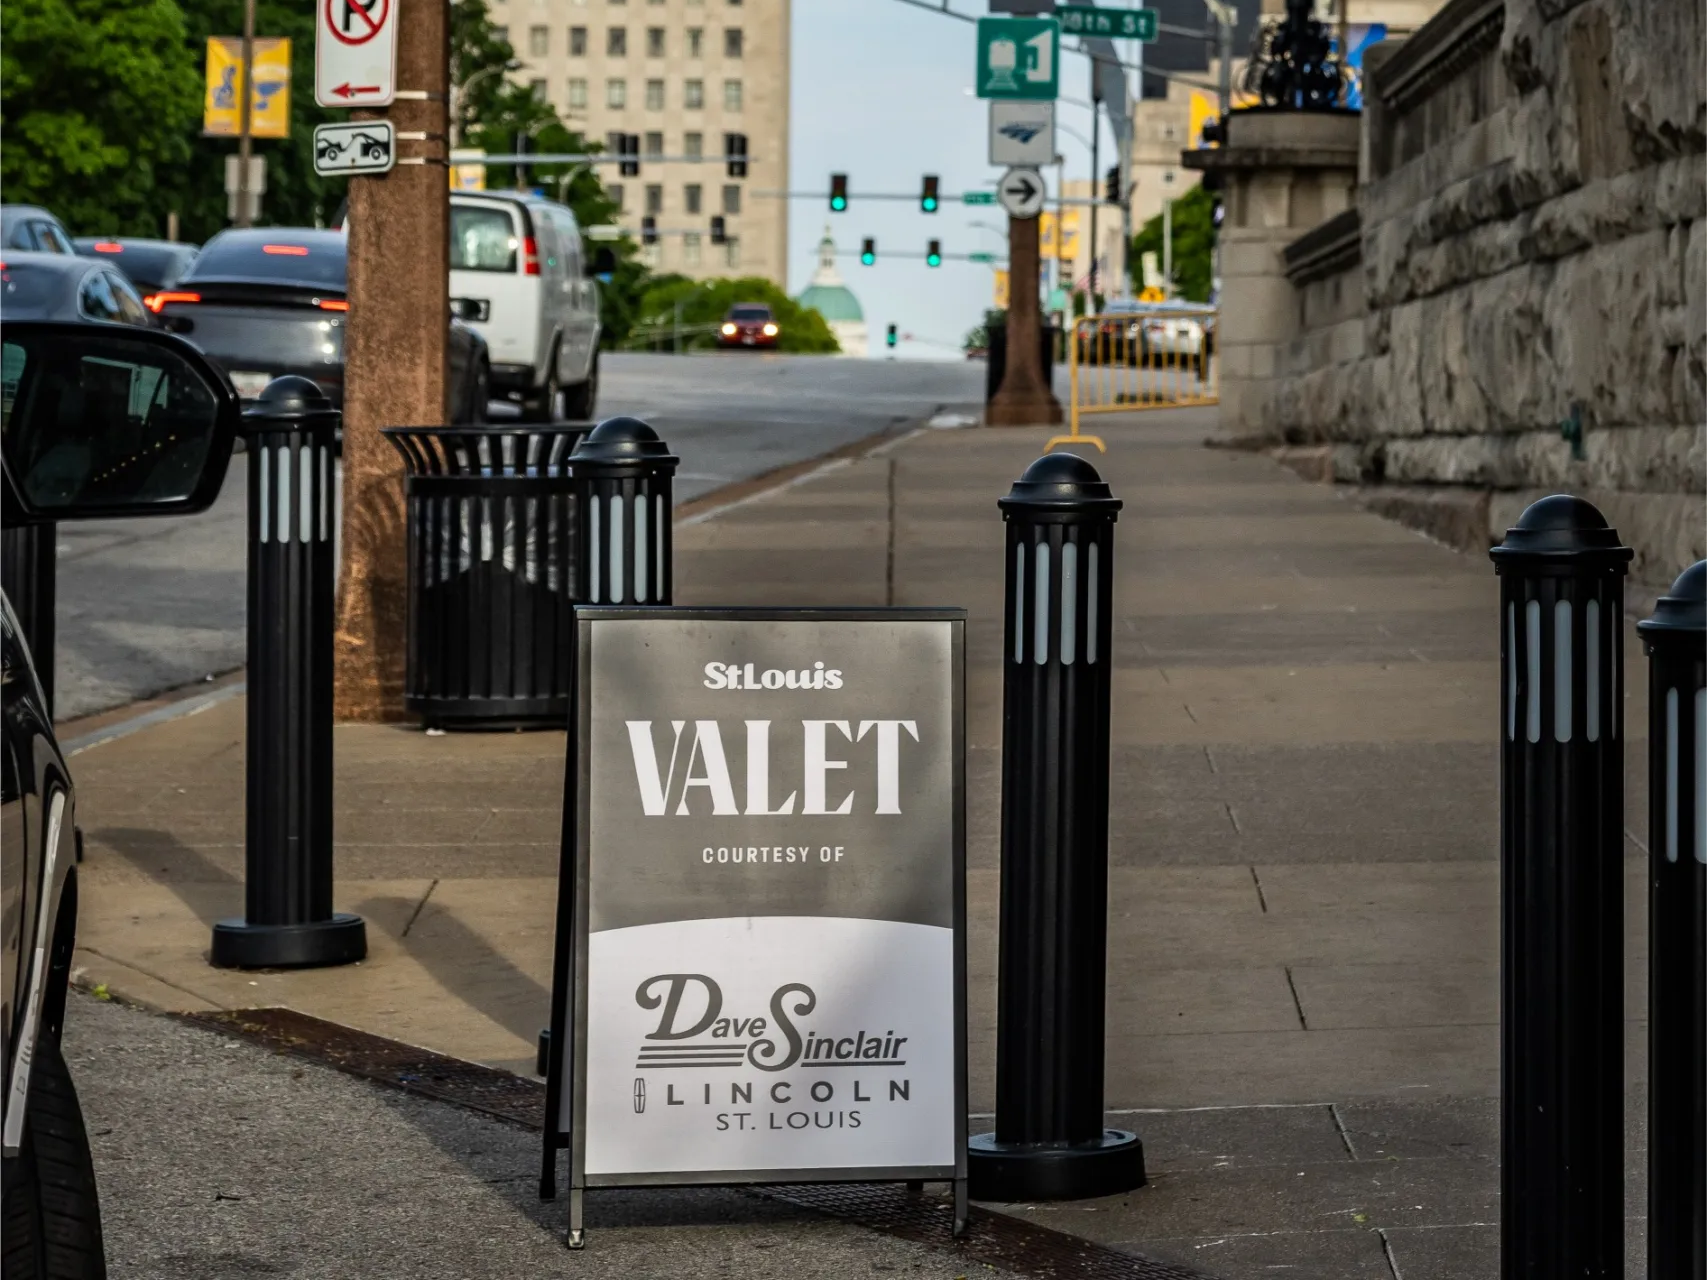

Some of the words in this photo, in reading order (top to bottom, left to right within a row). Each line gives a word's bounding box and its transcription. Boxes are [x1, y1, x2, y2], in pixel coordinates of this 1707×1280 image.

[625, 720, 920, 816] VALET
[702, 846, 810, 864] COURTESY
[819, 846, 845, 863] OF
[635, 973, 767, 1040] Dave
[747, 982, 908, 1072] Sinclair
[667, 1079, 911, 1106] LINCOLN
[716, 1113, 757, 1131] ST.
[769, 1110, 862, 1131] LOUIS
